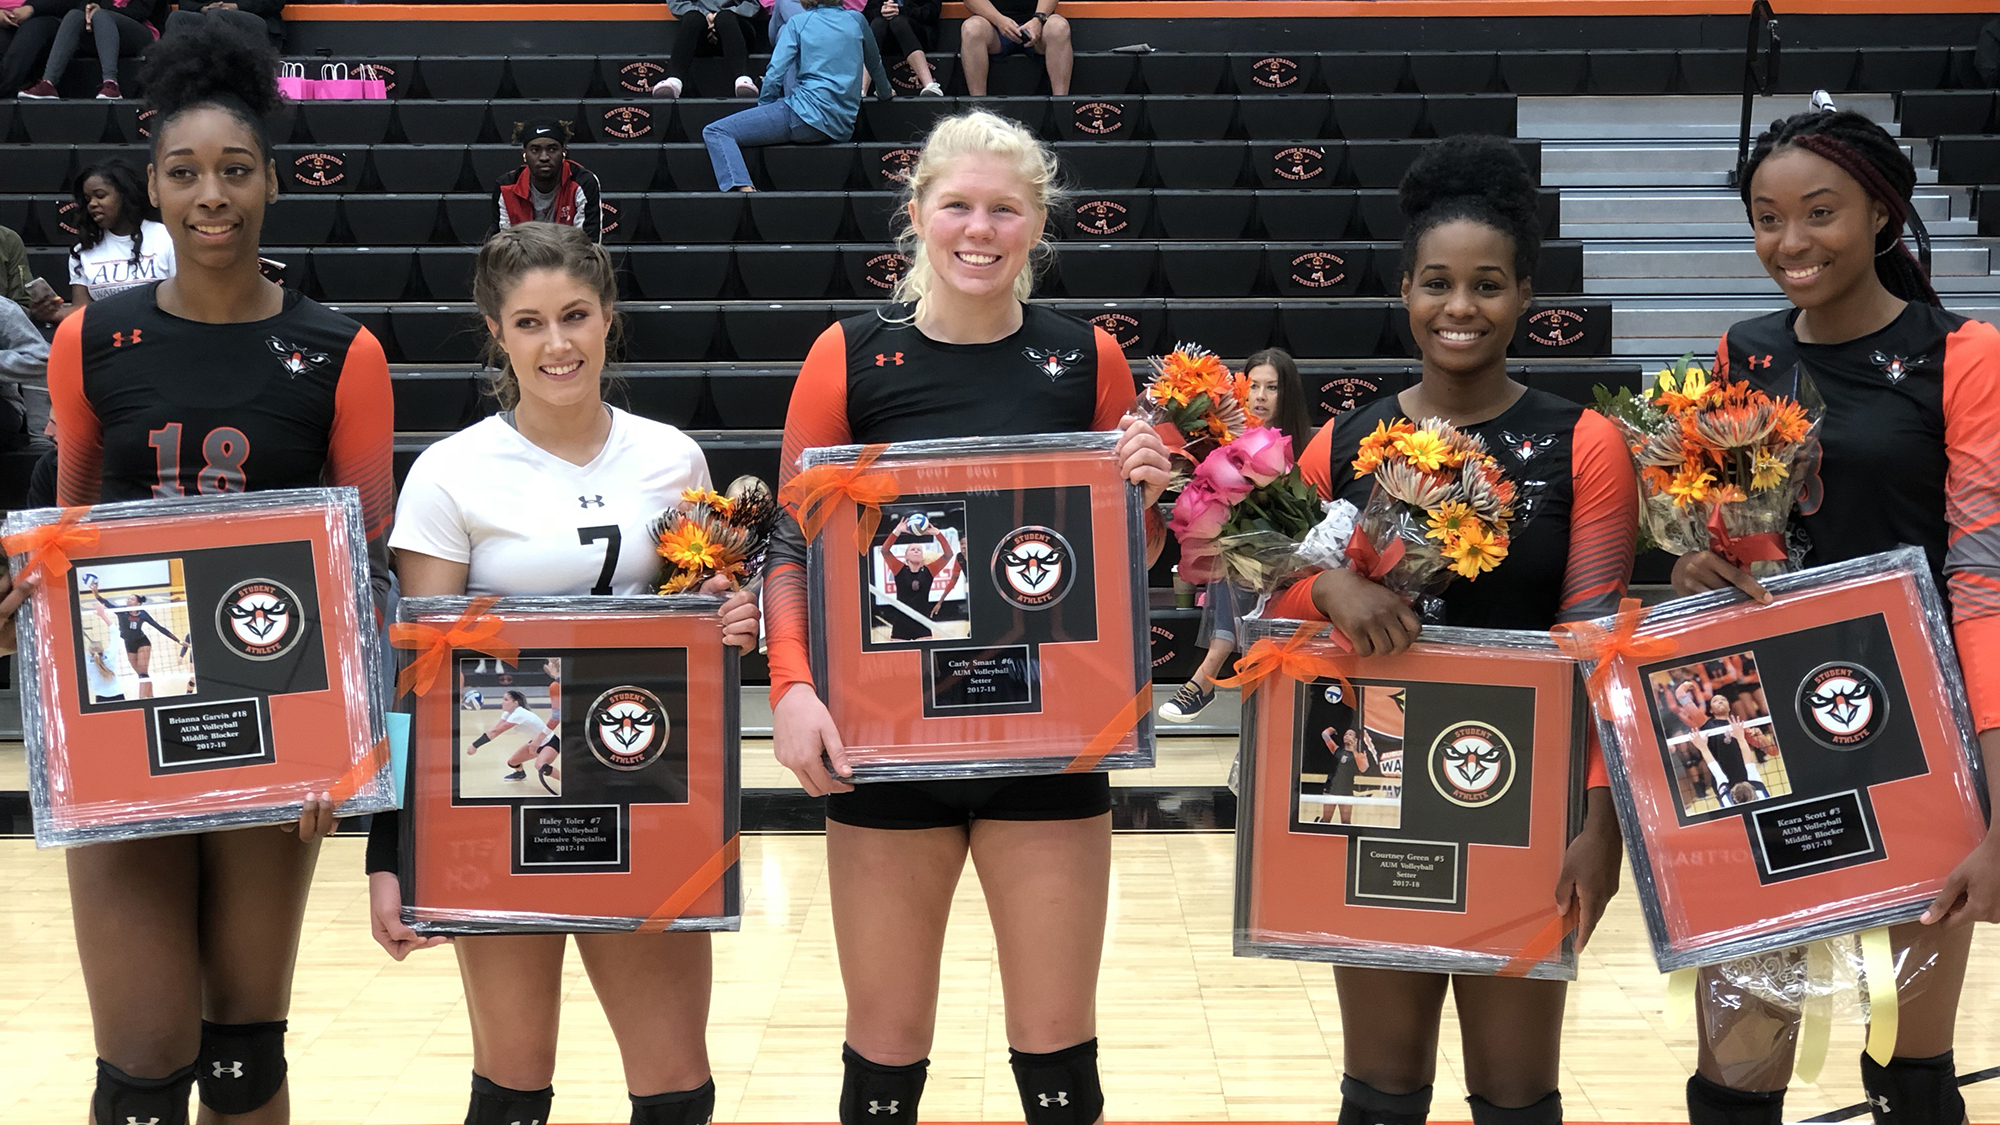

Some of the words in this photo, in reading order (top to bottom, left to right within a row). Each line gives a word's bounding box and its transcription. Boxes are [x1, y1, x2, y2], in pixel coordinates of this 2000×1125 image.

[620, 80, 644, 92] STUDENT
[1252, 76, 1276, 88] STUDENT
[628, 106, 650, 118] CRAZIES
[1099, 102, 1122, 115] CRAZIES
[604, 125, 628, 138] STUDENT
[629, 125, 651, 138] SECTION
[1075, 121, 1099, 134] STUDENT
[1100, 121, 1122, 134] SECTION
[319, 153, 343, 165] CRAZIES
[1298, 147, 1322, 159] CRAZIES
[295, 173, 320, 186] STUDENT
[321, 172, 345, 186] SECTION
[1274, 167, 1299, 180] STUDENT
[1300, 167, 1323, 180] SECTION
[1102, 200, 1127, 213] CRAZIES
[1076, 221, 1102, 235] STUDENT
[1103, 221, 1127, 235] SECTION
[1318, 252, 1344, 265] CRAZIES
[92, 259, 157, 285] AUM
[866, 275, 893, 289] STUDENT
[1291, 273, 1319, 287] STUDENT
[1320, 273, 1345, 287] SECTION
[1112, 313, 1139, 327] CRAZIES
[1528, 309, 1555, 324] CURTISS
[1557, 309, 1584, 323] CRAZIES
[1528, 332, 1557, 346] STUDENT
[1558, 331, 1584, 346] SECTION
[1320, 378, 1349, 393] CURTISS
[1350, 378, 1379, 392] CRAZIES
[148, 422, 251, 499] 18
[1014, 534, 1051, 544] STUDENT
[577, 524, 622, 595] 7
[238, 585, 277, 597] STUDENT
[1016, 594, 1053, 604] ATHLETE
[245, 642, 282, 655] ATHLETE
[948, 660, 970, 669] Carly
[972, 659, 996, 667] Smart
[973, 668, 1009, 677] Volleyball
[1814, 669, 1853, 684] STUDENT
[966, 686, 997, 694] 2017-18
[609, 693, 646, 704] STUDENT
[168, 716, 201, 725] Brianna
[202, 713, 230, 721] Garvin
[232, 710, 248, 719] #18
[180, 725, 200, 733] AUM
[202, 721, 239, 731] Volleyball
[181, 734, 209, 743] Middle
[210, 731, 239, 740] Blocker
[1454, 729, 1492, 740] STUDENT
[1832, 729, 1870, 744] ATHLETE
[196, 741, 227, 751] 2017-18
[610, 754, 645, 764] ATHLETE
[1452, 790, 1489, 801] ATHLETE
[539, 818, 562, 827] Haley
[565, 817, 585, 825] Toler
[1777, 817, 1803, 827] Keara
[1804, 811, 1827, 821] Scott
[563, 827, 599, 836] Volleyball
[1782, 826, 1802, 837] AUM
[1804, 817, 1843, 831] Volleyball
[572, 836, 607, 844] Specialist
[1784, 834, 1813, 846] Middle
[1814, 828, 1844, 839] Blocker
[1801, 839, 1834, 852] 2017-18
[1370, 850, 1405, 862] Courtney
[1406, 853, 1430, 862] Green
[1379, 861, 1398, 869] AUM
[1400, 862, 1434, 871] Volleyball
[1396, 871, 1417, 879] Setter
[1392, 879, 1421, 888] 2017-18
